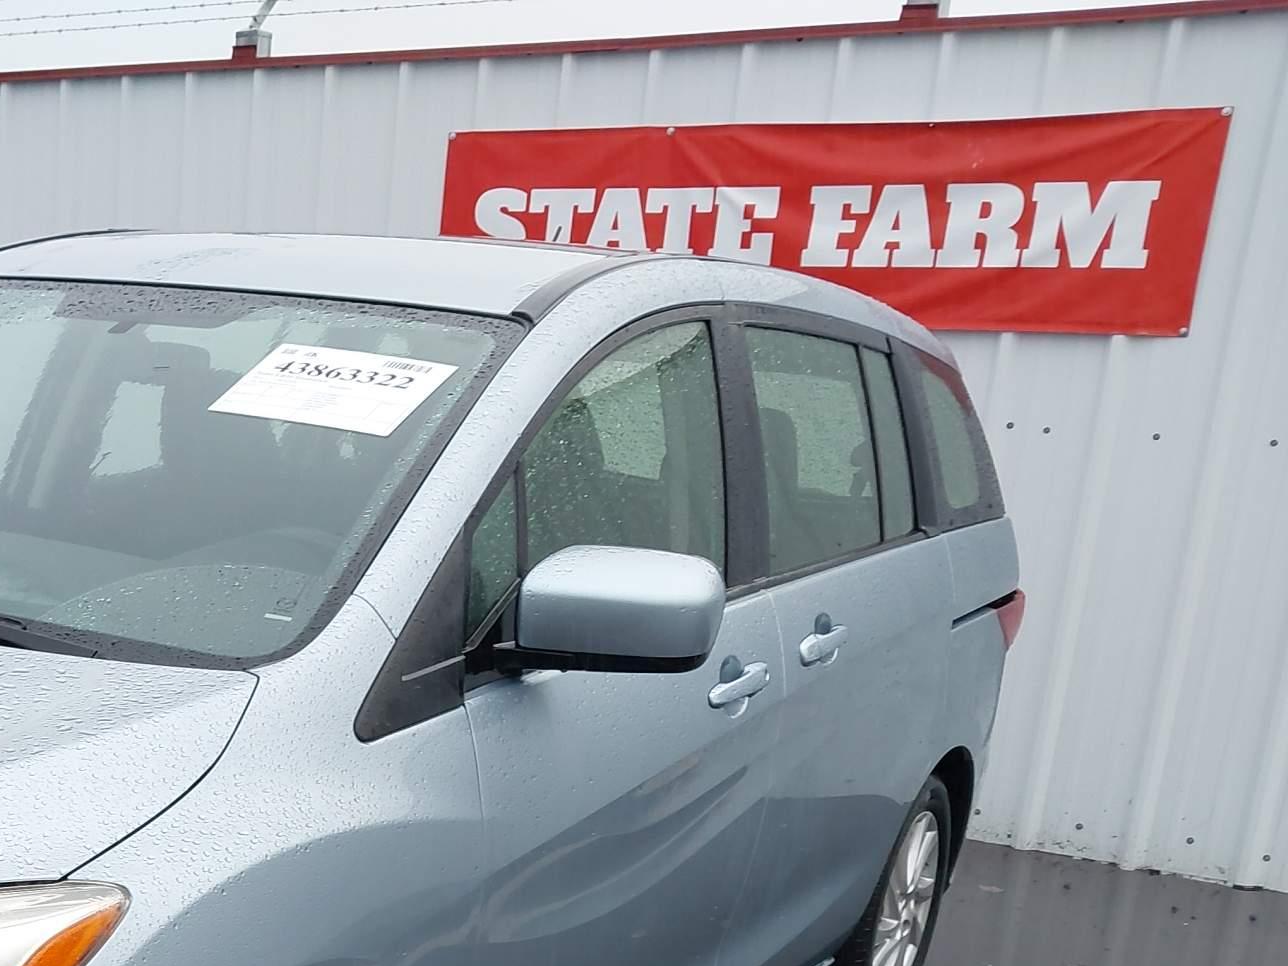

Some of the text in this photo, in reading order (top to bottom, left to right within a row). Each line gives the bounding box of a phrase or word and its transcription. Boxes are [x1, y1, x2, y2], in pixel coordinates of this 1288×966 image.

[474, 179, 1162, 269] STATE FARM
[274, 359, 415, 390] 43863322
